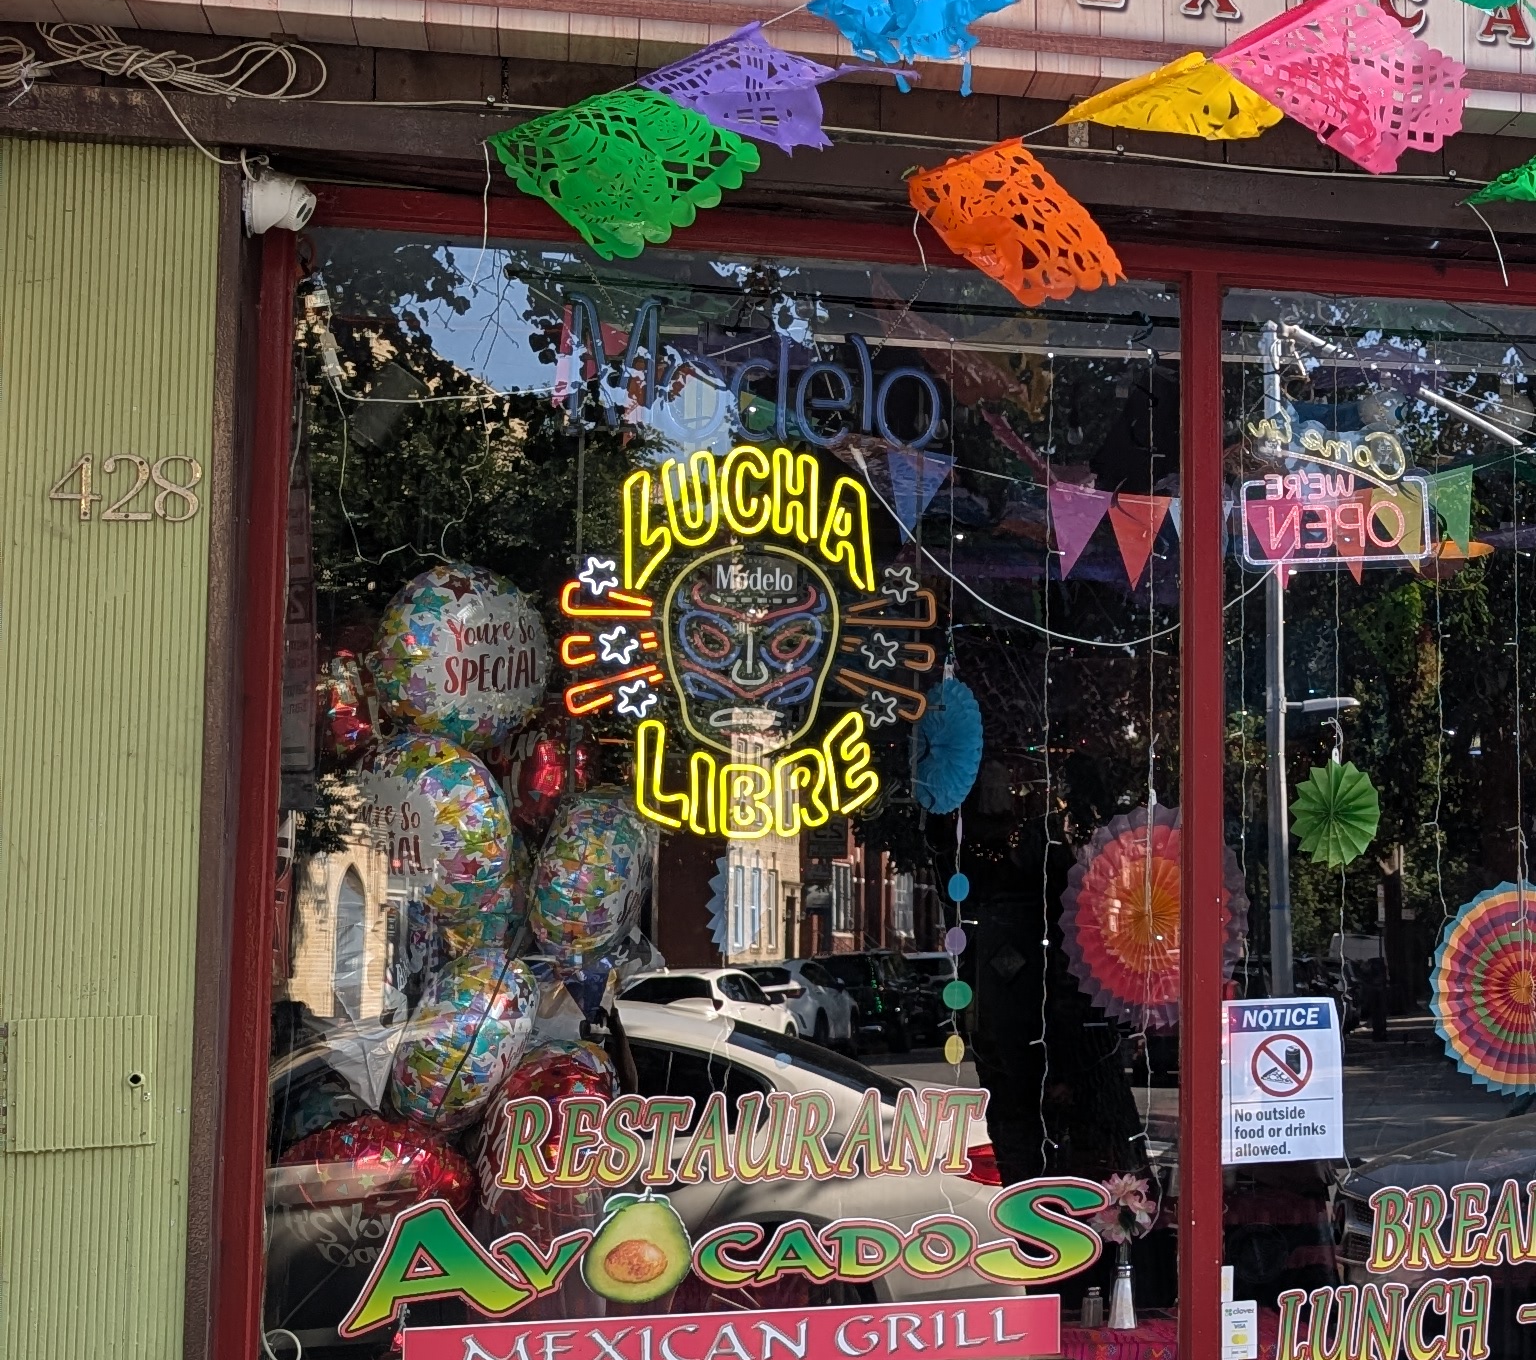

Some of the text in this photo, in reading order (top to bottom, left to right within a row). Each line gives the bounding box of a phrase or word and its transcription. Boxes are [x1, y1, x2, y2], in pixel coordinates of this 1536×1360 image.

[566, 290, 942, 449] Modelo
[49, 452, 204, 523] 428
[622, 444, 876, 593] LUCHA
[716, 564, 793, 592] Modelo
[634, 710, 879, 840] LIBRE
[1242, 1007, 1320, 1029] NOTICE
[1234, 1106, 1306, 1122] No outside
[1234, 1122, 1327, 1139] food or drinks
[495, 1087, 992, 1190] RESTAURANT
[1235, 1141, 1292, 1157] allowed.
[835, 1305, 1029, 1357] GRILL
[1232, 1307, 1254, 1315] clover
